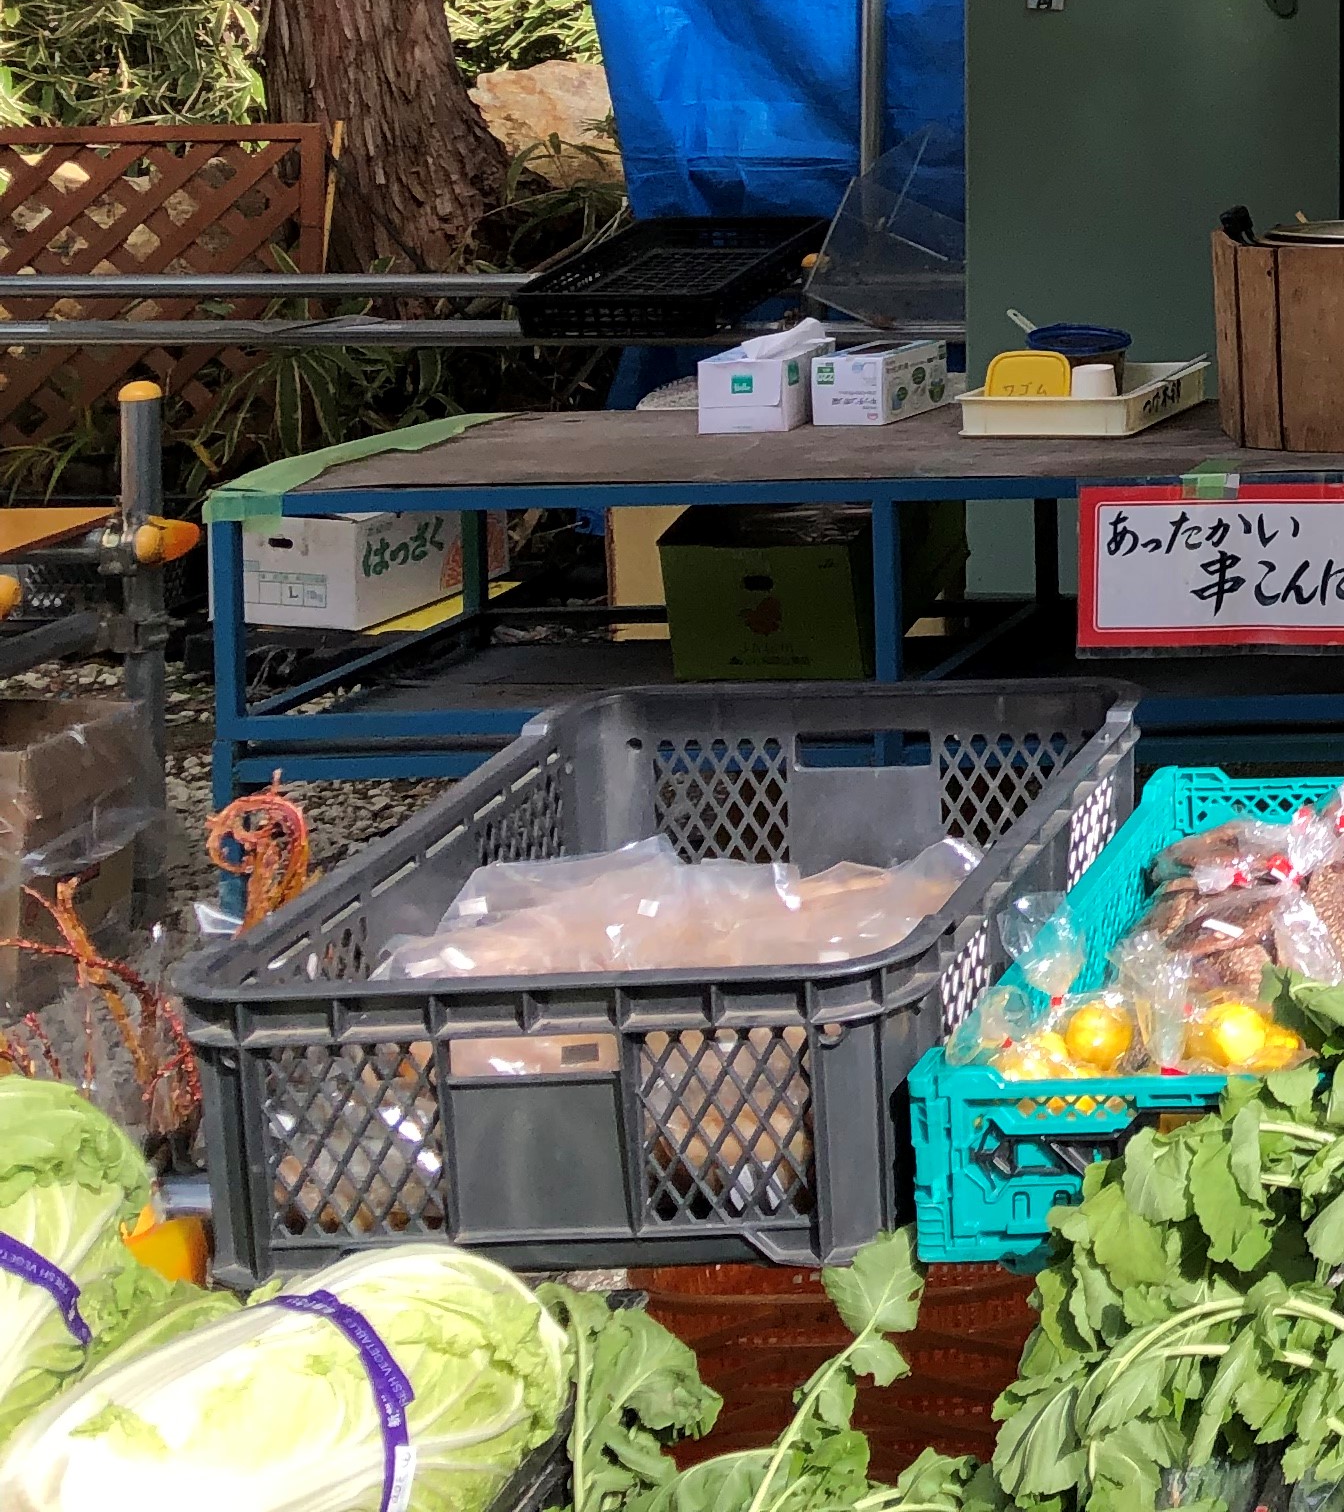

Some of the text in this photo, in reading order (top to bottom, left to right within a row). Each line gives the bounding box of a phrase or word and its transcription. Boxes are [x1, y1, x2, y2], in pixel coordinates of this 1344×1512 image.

[361, 515, 444, 578] はっさく
[1106, 510, 1300, 557] あったかい
